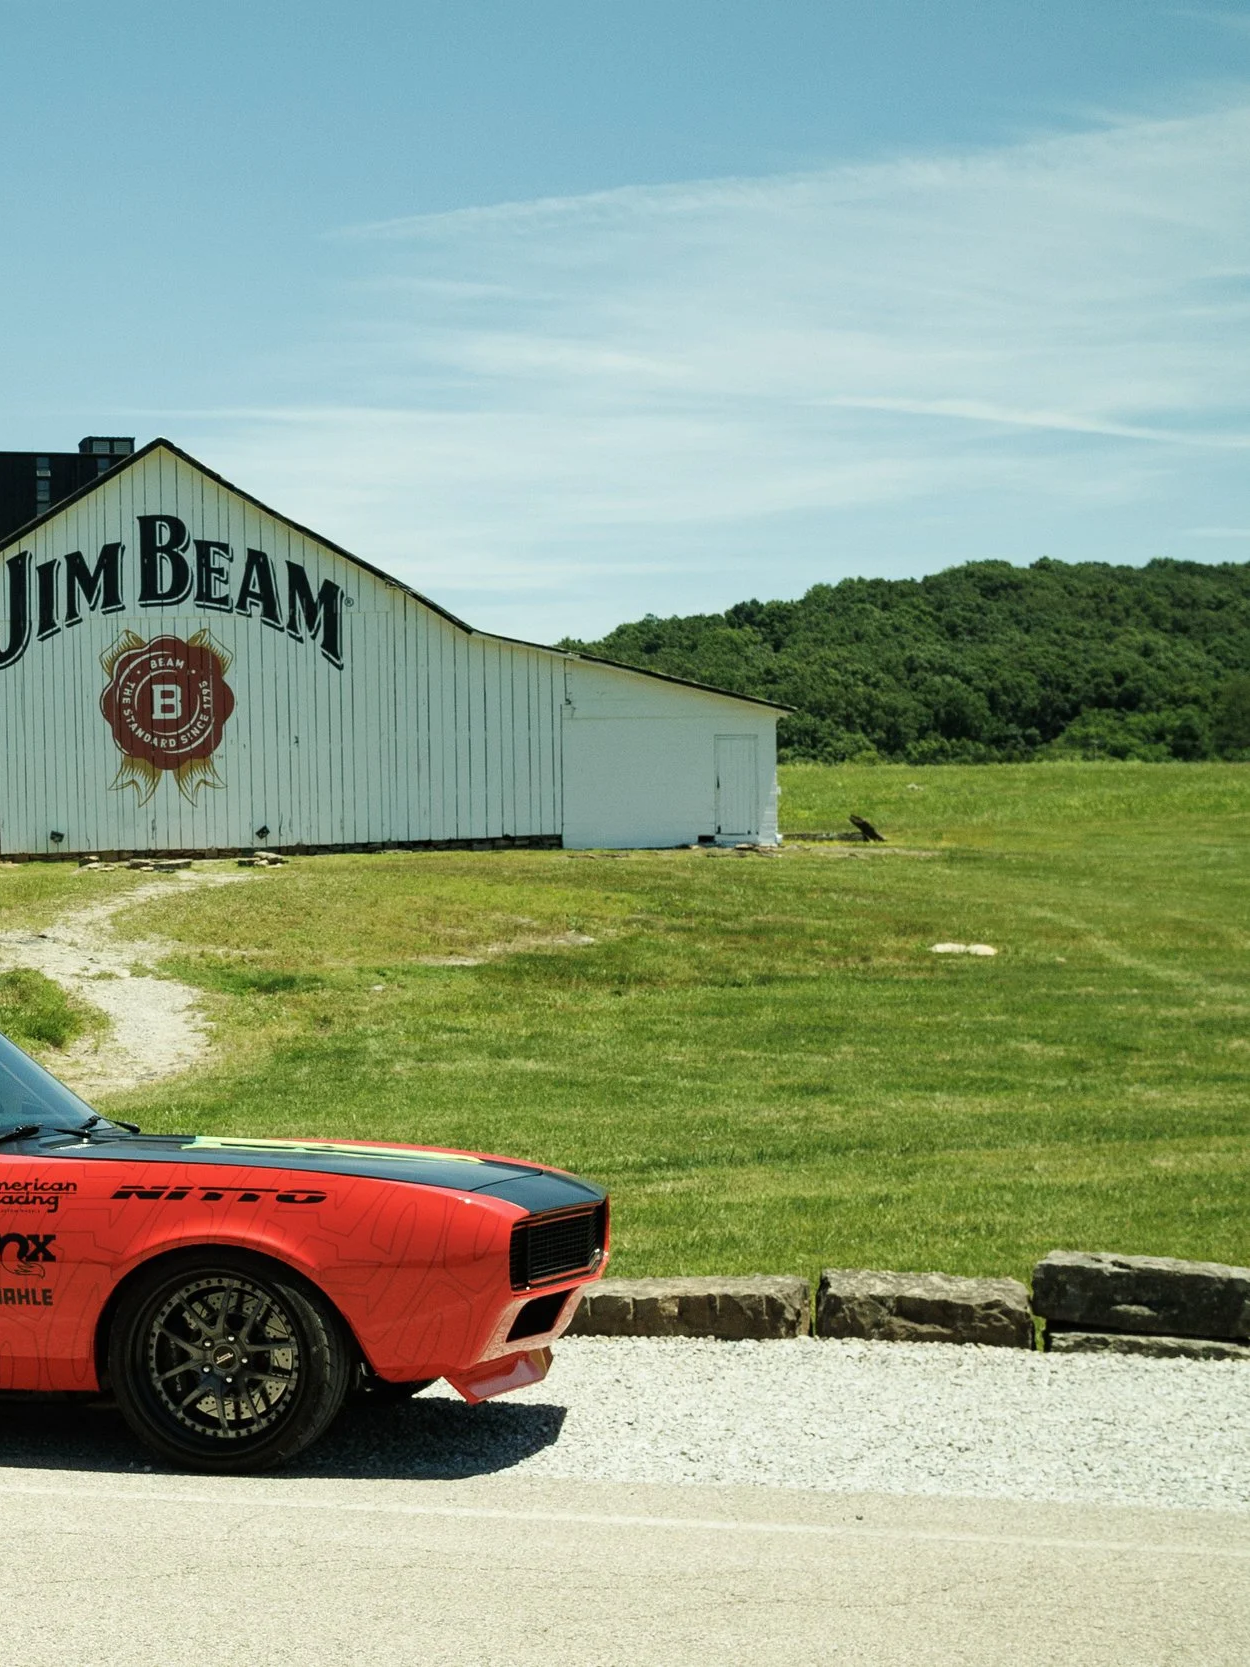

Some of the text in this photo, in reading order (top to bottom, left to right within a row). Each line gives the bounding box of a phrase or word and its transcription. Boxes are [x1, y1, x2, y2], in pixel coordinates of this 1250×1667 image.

[136, 514, 344, 670] BEAM
[150, 657, 184, 669] BEAM
[123, 680, 211, 748] THE STANDARD SINCE 1795
[152, 684, 182, 719] B
[109, 1185, 328, 1204] NITTO
